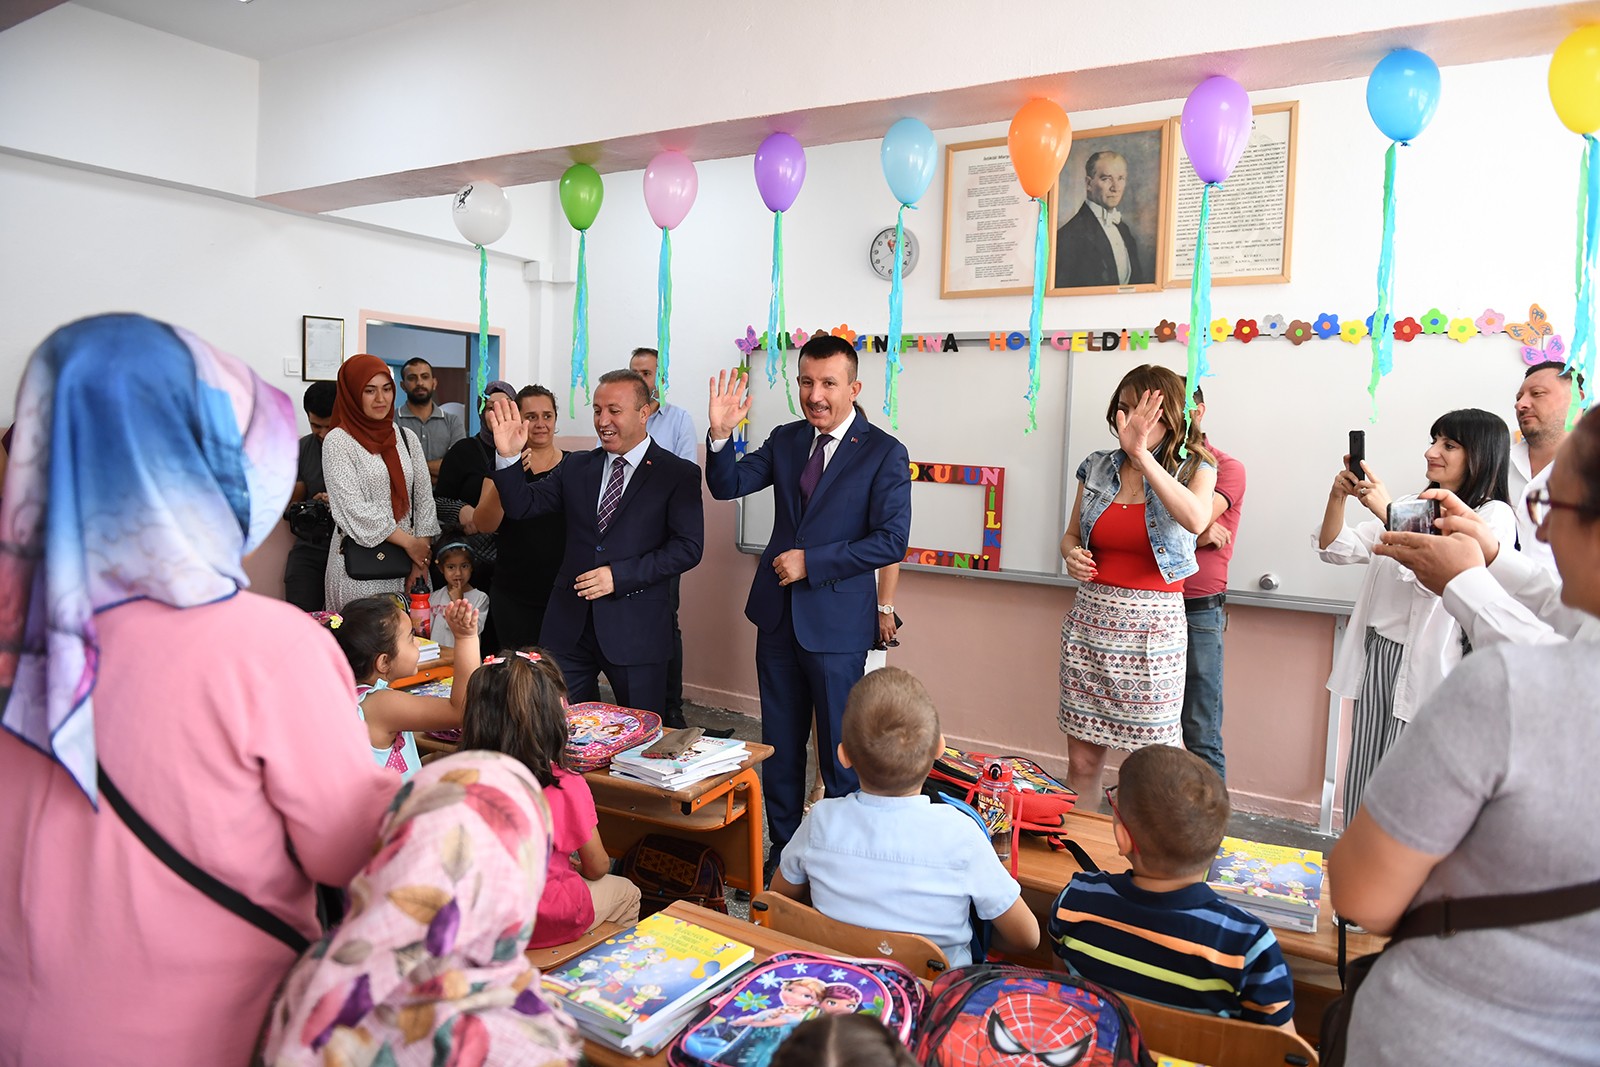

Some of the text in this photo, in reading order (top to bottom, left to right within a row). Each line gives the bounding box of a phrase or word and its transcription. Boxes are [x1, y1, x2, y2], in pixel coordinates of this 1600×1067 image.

[855, 328, 1150, 354] SINFINA HO GELDİN
[909, 462, 1000, 486] OKULUN
